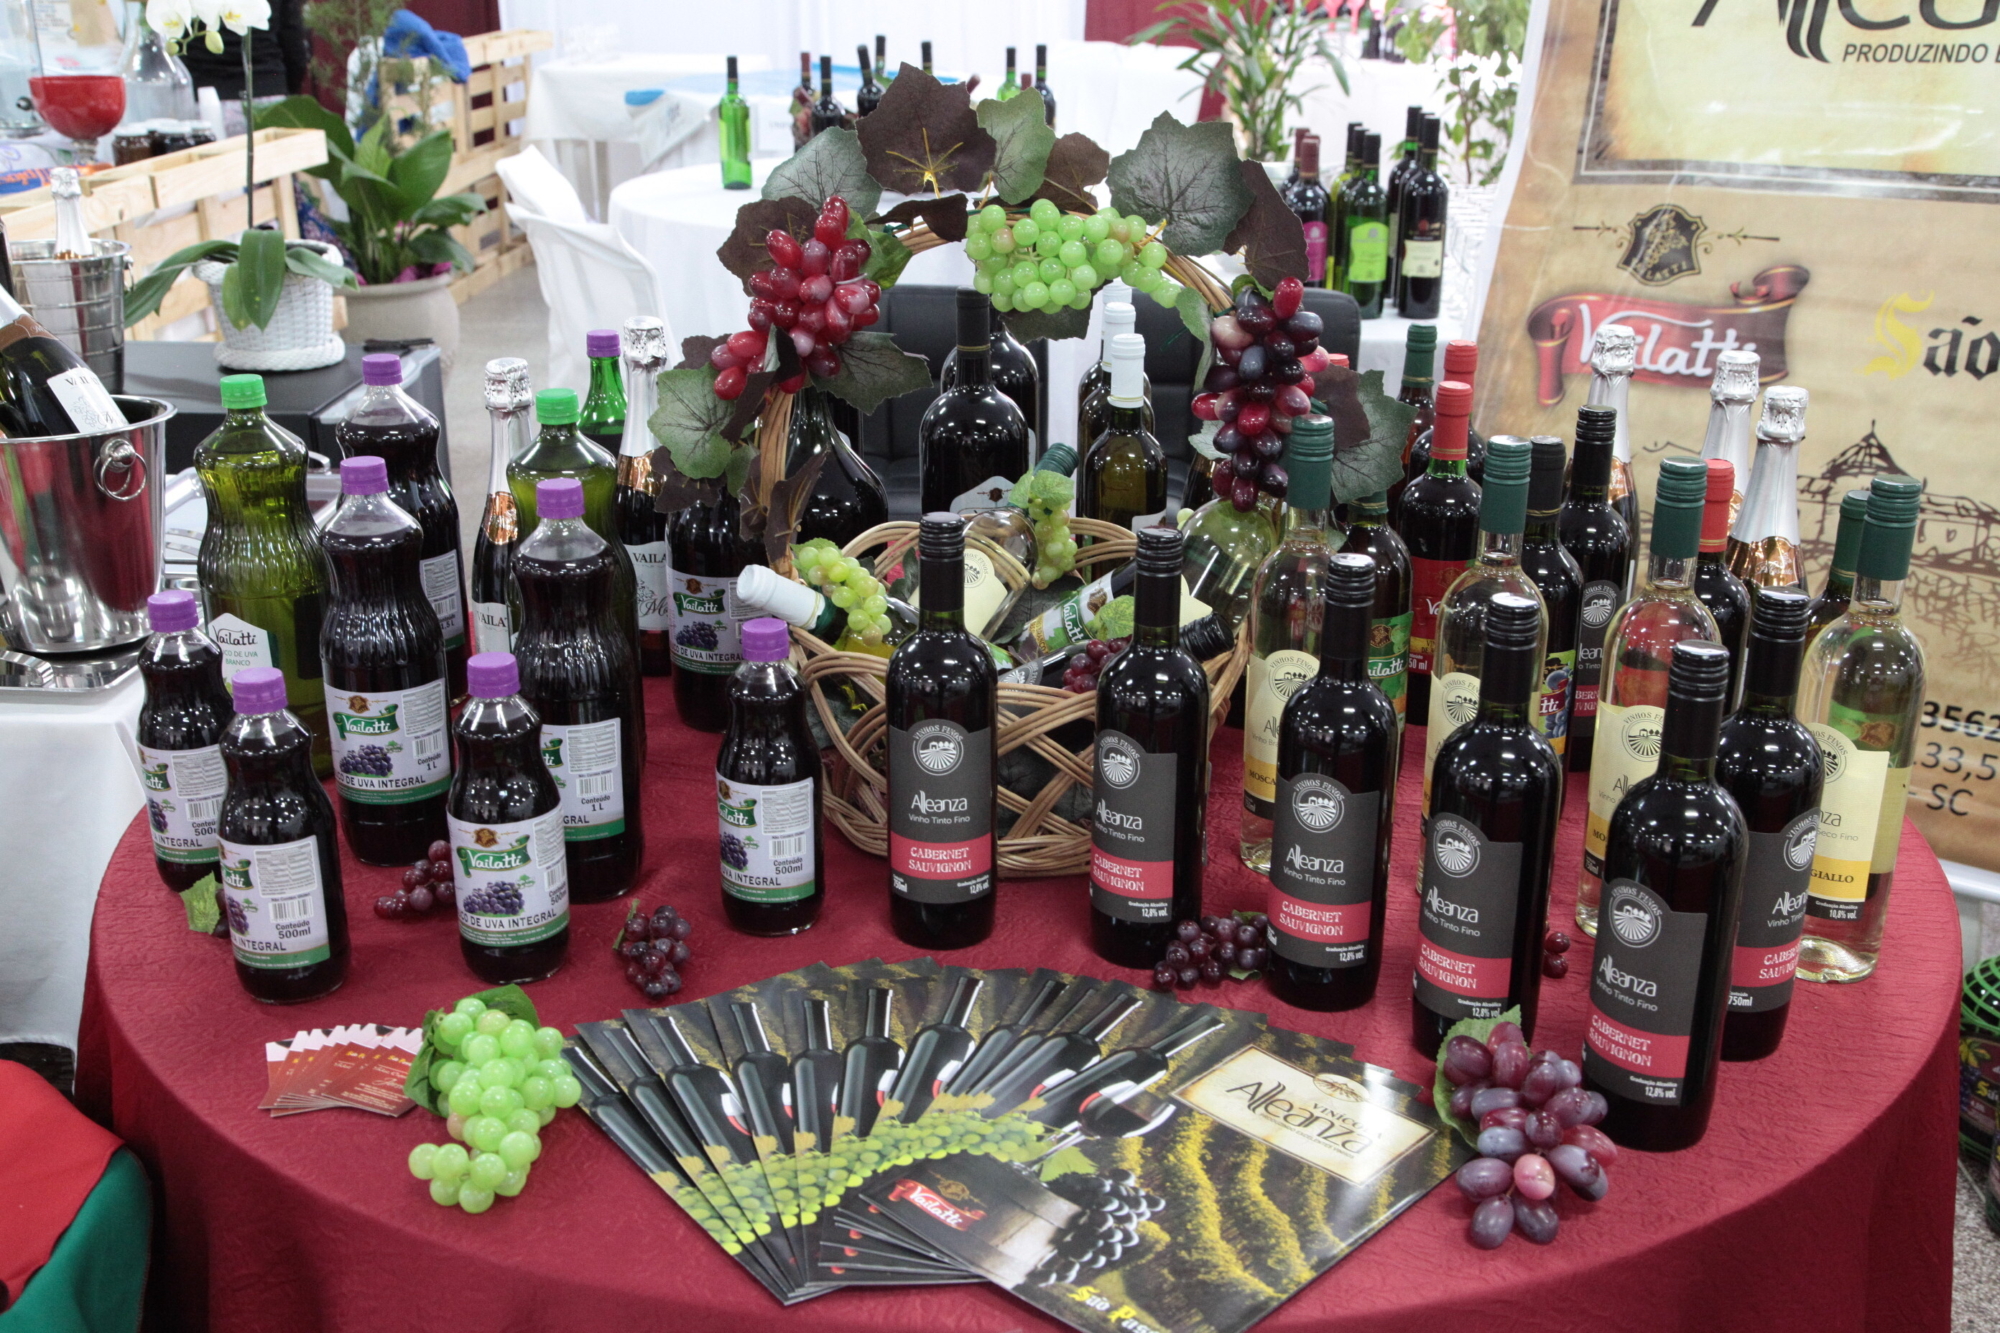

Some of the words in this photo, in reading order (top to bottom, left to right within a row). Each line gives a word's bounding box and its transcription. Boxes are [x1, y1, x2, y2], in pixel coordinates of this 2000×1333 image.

[1843, 44, 1989, 63] PRODUZINDO
[633, 553, 666, 563] VAILA
[681, 595, 718, 613] Vailatti
[1064, 595, 1085, 642] Vailatt
[212, 625, 257, 645] Vailatti
[226, 658, 250, 666] BRANCO
[681, 647, 689, 656] DE
[690, 649, 703, 659] UVA
[1269, 656, 1294, 669] VINHOS
[342, 715, 391, 733] Vailatti
[1623, 712, 1652, 725] VINHOS
[913, 725, 940, 741] VINHOS
[942, 725, 964, 743] FINOS
[1120, 739, 1140, 760] FINOS
[1827, 735, 1848, 756] FINOS
[346, 775, 355, 786] DE
[358, 779, 375, 788] UVA
[378, 775, 426, 788] INTEGRAL
[1249, 769, 1277, 785] MOSCA
[1293, 779, 1320, 792] VINHOS
[1322, 782, 1346, 802] FINOS
[1926, 783, 1973, 816] SC
[581, 795, 610, 805] Conteúdo
[911, 790, 968, 815] Alleanza
[563, 815, 590, 824] GRAL
[908, 813, 930, 824] Vinho
[954, 815, 970, 823] Fino
[1096, 798, 1143, 831] Alleanza
[192, 820, 216, 829] Conteú
[159, 837, 202, 848] INTEGRAL
[1109, 828, 1126, 840] Tinto
[1127, 833, 1145, 843] Fino
[1458, 823, 1482, 847] FINOS
[1840, 832, 1859, 842] Fino
[466, 849, 522, 869] Vailatti
[910, 847, 969, 861] CABERNET
[1286, 844, 1344, 874] Alleanza
[775, 864, 803, 875] 500ml
[909, 860, 972, 873] SAUVIGNON
[1094, 854, 1143, 879] CABERNET
[1810, 867, 1854, 884] GIALLO
[735, 872, 781, 886] INTEGRAL
[1093, 865, 1145, 892] SAUVIGNON
[1283, 866, 1303, 880] Vinho
[1305, 873, 1325, 885] Tinto
[1328, 877, 1346, 886] Fino
[1282, 901, 1342, 923] CABERNET
[1426, 885, 1479, 924] Alleanza
[1638, 890, 1664, 917] FINOS
[1772, 891, 1808, 916] Allean
[471, 915, 481, 927] DE
[485, 919, 505, 929] UVA
[508, 908, 557, 928] INTEGRAL
[1829, 908, 1846, 919] 10,8%
[276, 920, 310, 930] Conteúdo
[1280, 912, 1344, 936] SAUVIGNON
[1440, 919, 1459, 932] Tinto
[1461, 926, 1481, 937] Fino
[1767, 917, 1790, 929] Vinho
[278, 927, 311, 939] 500ml
[240, 939, 286, 951] INTEGRAL
[1421, 943, 1475, 975] CABERNET
[1419, 955, 1478, 989] SAUVIGNON
[1599, 954, 1657, 998] Alleanza
[1613, 990, 1635, 1006] Tinto
[1637, 999, 1658, 1012] Fino
[1472, 1007, 1490, 1018] 12,8%
[1592, 1014, 1652, 1052] CABERNET
[1588, 1028, 1652, 1067] SAUVIGNON
[1225, 1081, 1373, 1154] Alleanza
[909, 1185, 963, 1229] Vailatti
